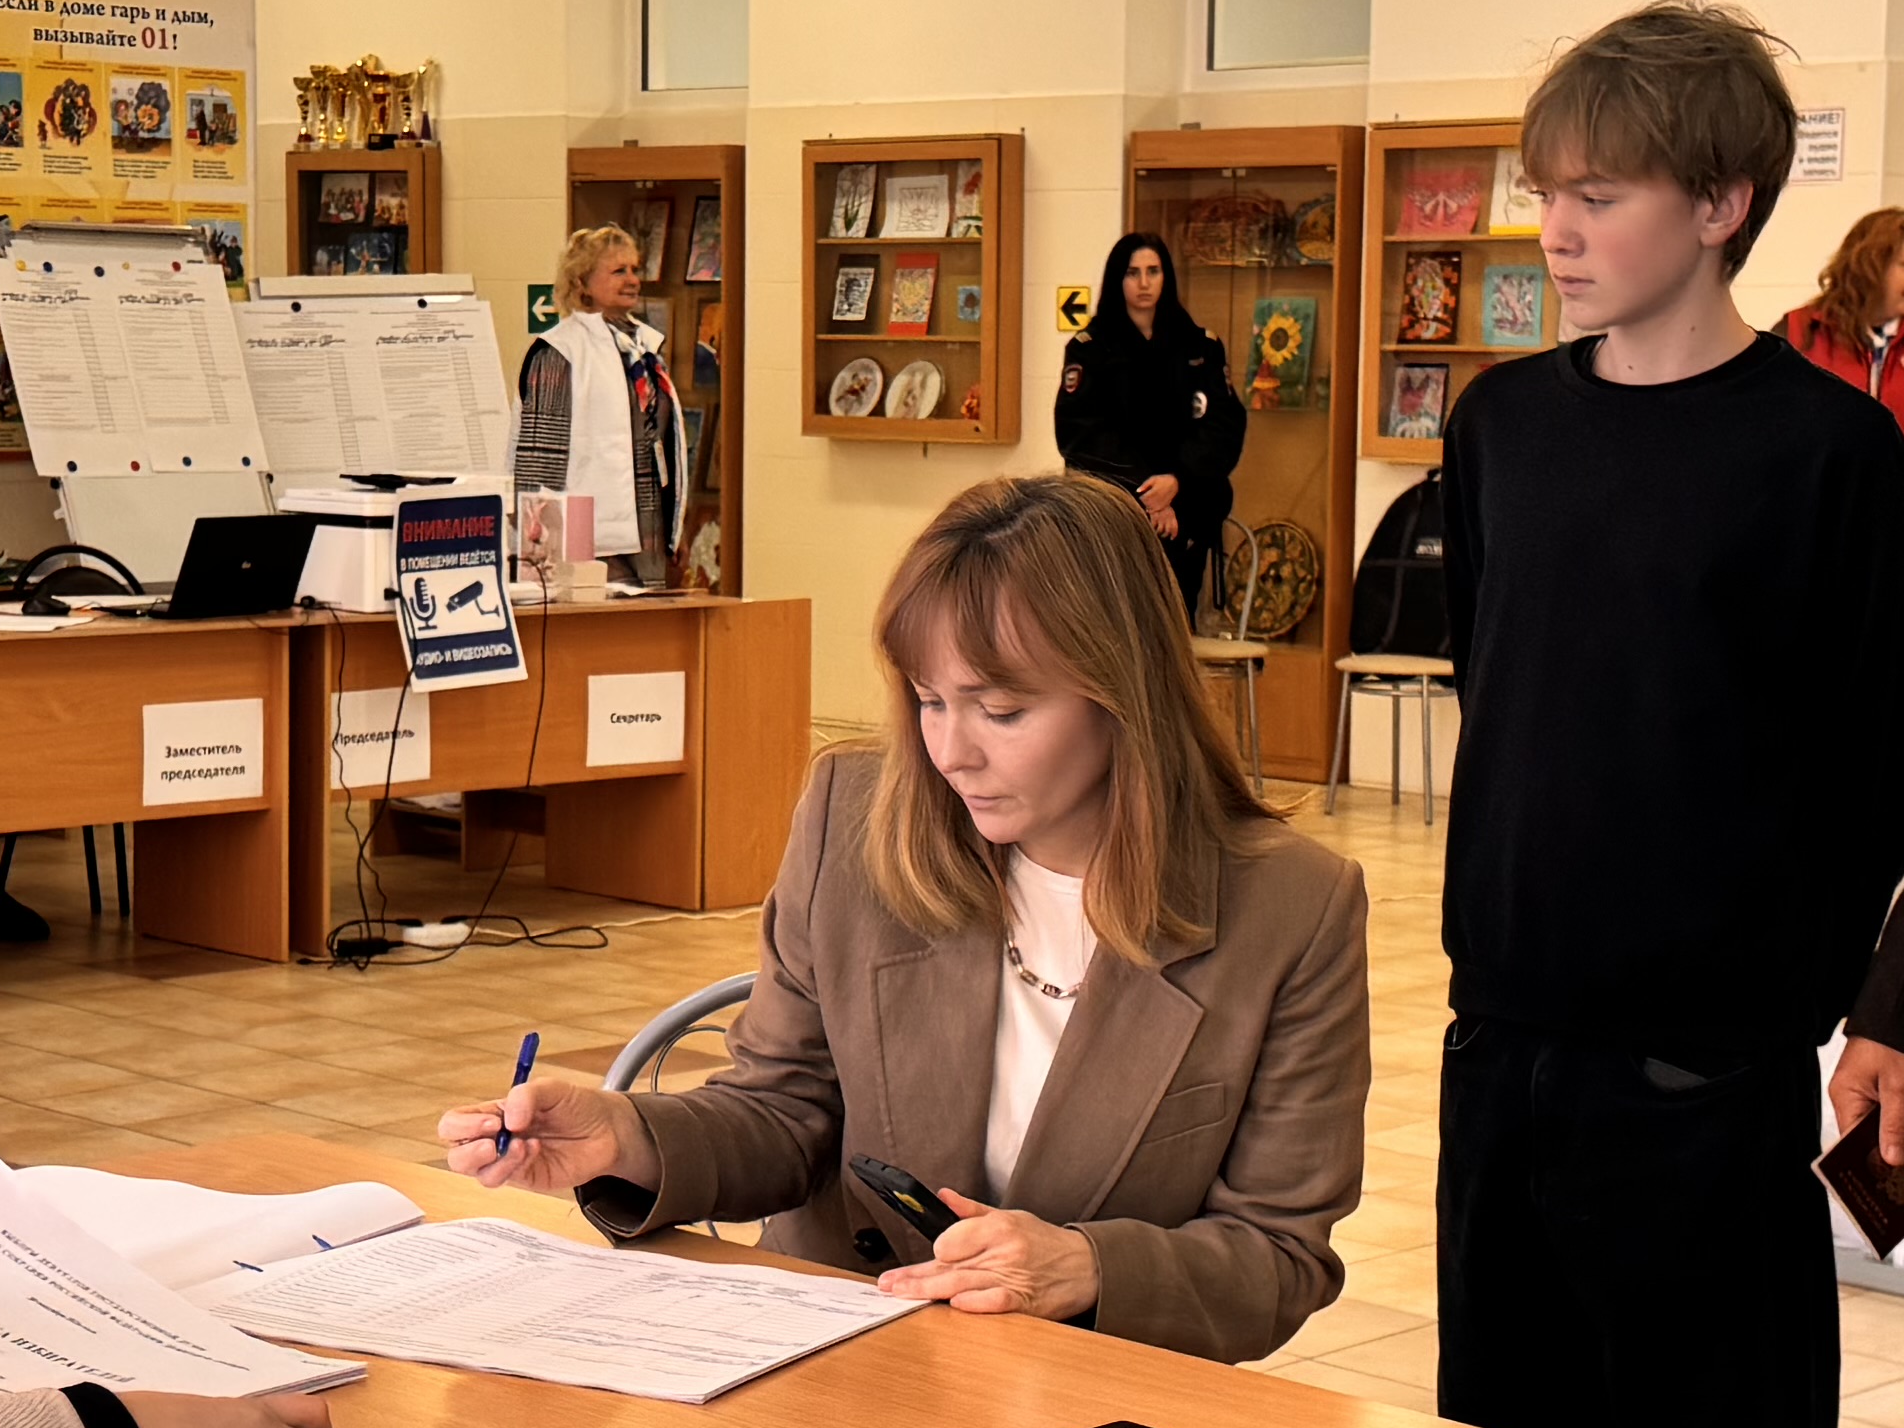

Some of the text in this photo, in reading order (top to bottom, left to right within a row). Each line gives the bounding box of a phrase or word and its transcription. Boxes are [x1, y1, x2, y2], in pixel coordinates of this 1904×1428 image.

[44, 0, 55, 13] в
[59, 0, 105, 17] доме
[110, 3, 150, 22] гарь
[155, 8, 166, 21] и
[171, 10, 214, 27] дым,
[33, 27, 137, 48] вызывайте
[402, 516, 495, 543] ВНИМАНИЕ
[400, 558, 407, 571] В
[164, 744, 242, 758] Заместитель
[161, 764, 246, 781] председателя
